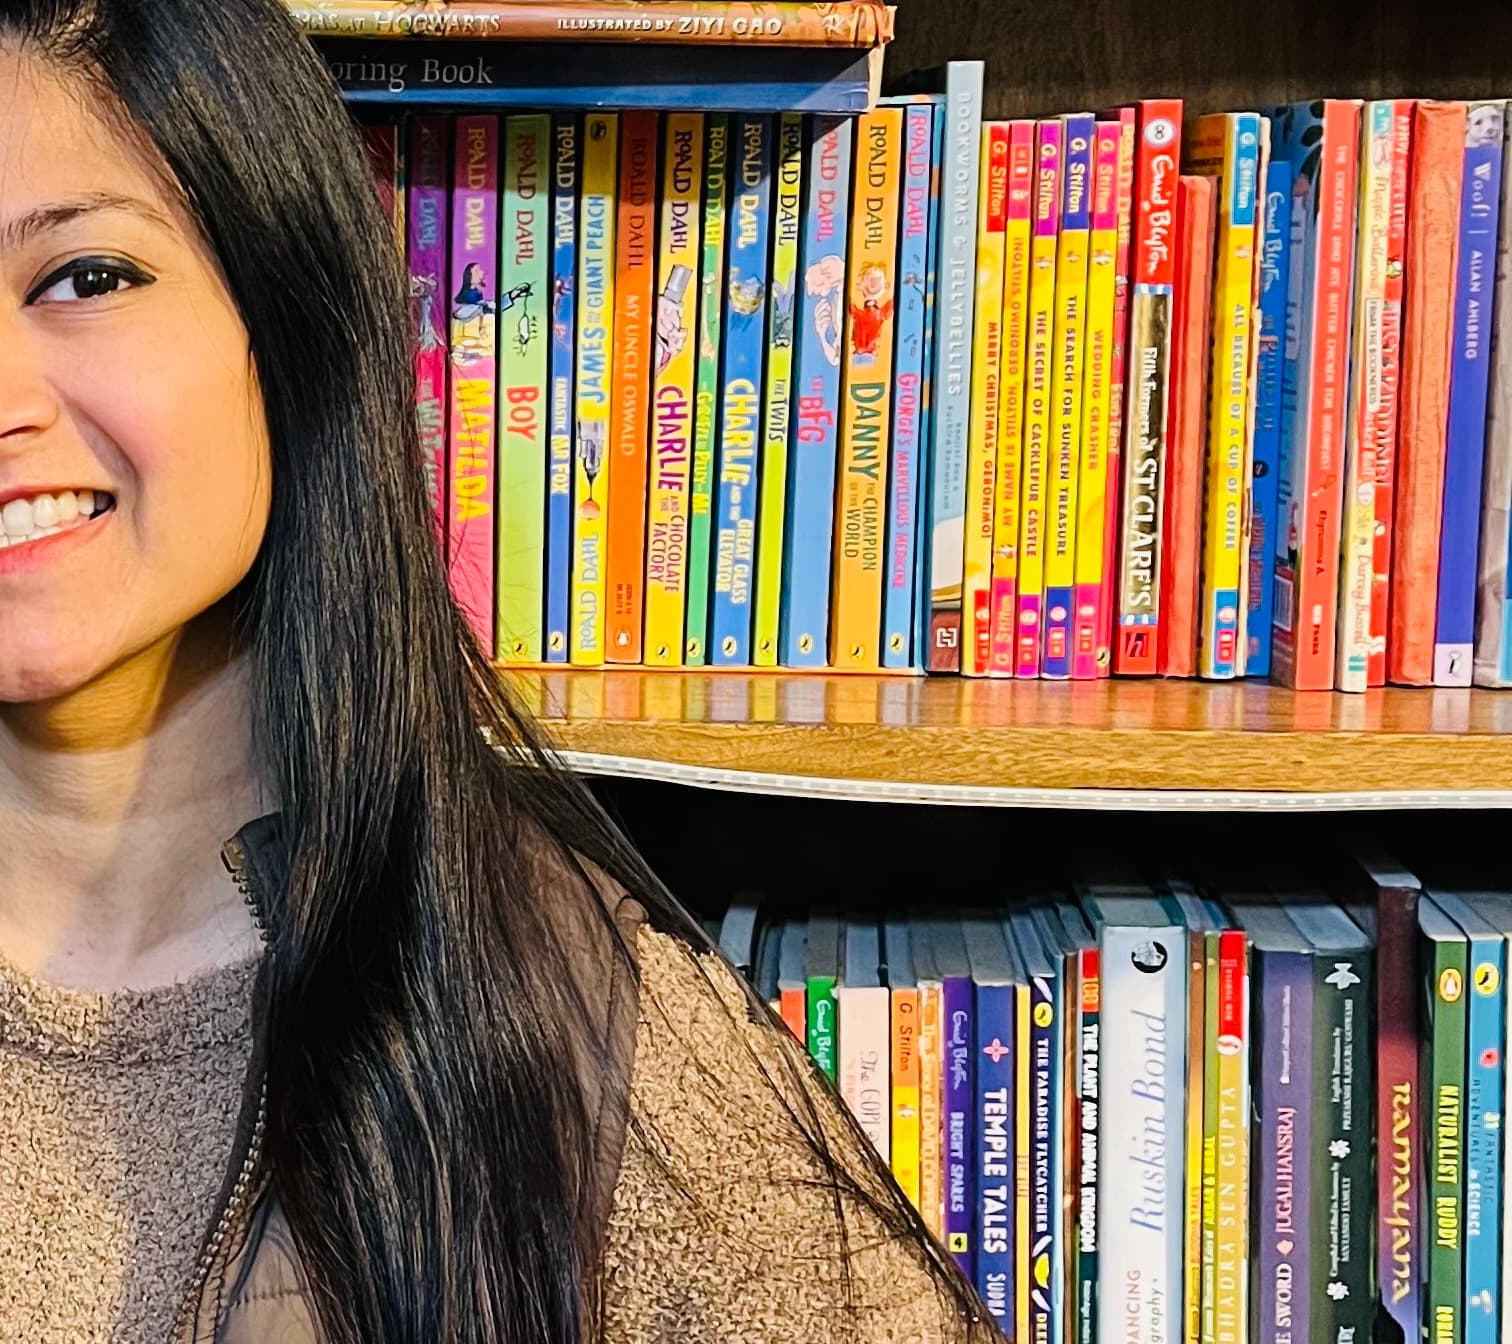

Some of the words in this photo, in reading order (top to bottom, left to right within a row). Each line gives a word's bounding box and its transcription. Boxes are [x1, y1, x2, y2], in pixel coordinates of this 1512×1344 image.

[374, 10, 503, 37] HOGWARTS
[557, 16, 653, 33] ILLUSTRATED
[656, 16, 673, 33] BY
[678, 15, 726, 36] ZIYI
[734, 15, 784, 37] GAO
[421, 57, 495, 85] Book
[468, 127, 487, 190] ROALD
[869, 123, 888, 190] ROALD
[957, 93, 973, 231] BOOKWORMS
[465, 197, 485, 251] DAHL
[865, 196, 885, 251] DAHL
[1470, 249, 1483, 295] ALLAN
[949, 262, 967, 398] JELLYBELLIES
[1064, 322, 1076, 381] SEARCH
[1466, 300, 1480, 360] AHLBERG
[507, 385, 539, 442] BOY
[655, 384, 686, 493] CHARLIE
[769, 396, 787, 445] TWITS
[798, 395, 826, 445] BFG
[849, 382, 886, 482] DANNY
[454, 377, 492, 523] MATILDA
[1061, 422, 1073, 482] SUNKEN
[649, 520, 668, 584] FACTORY
[665, 514, 686, 594] CHOCOLATE
[844, 509, 859, 559] WORLD
[863, 496, 879, 573] CHAMPION
[1057, 487, 1071, 557] TREASURE
[1127, 496, 1158, 608] CLARE'S
[1133, 1010, 1169, 1102] Bond
[984, 1087, 1007, 1176] TEMPLE
[1128, 1112, 1166, 1236] Ruskin
[982, 1186, 1006, 1255] TALES
